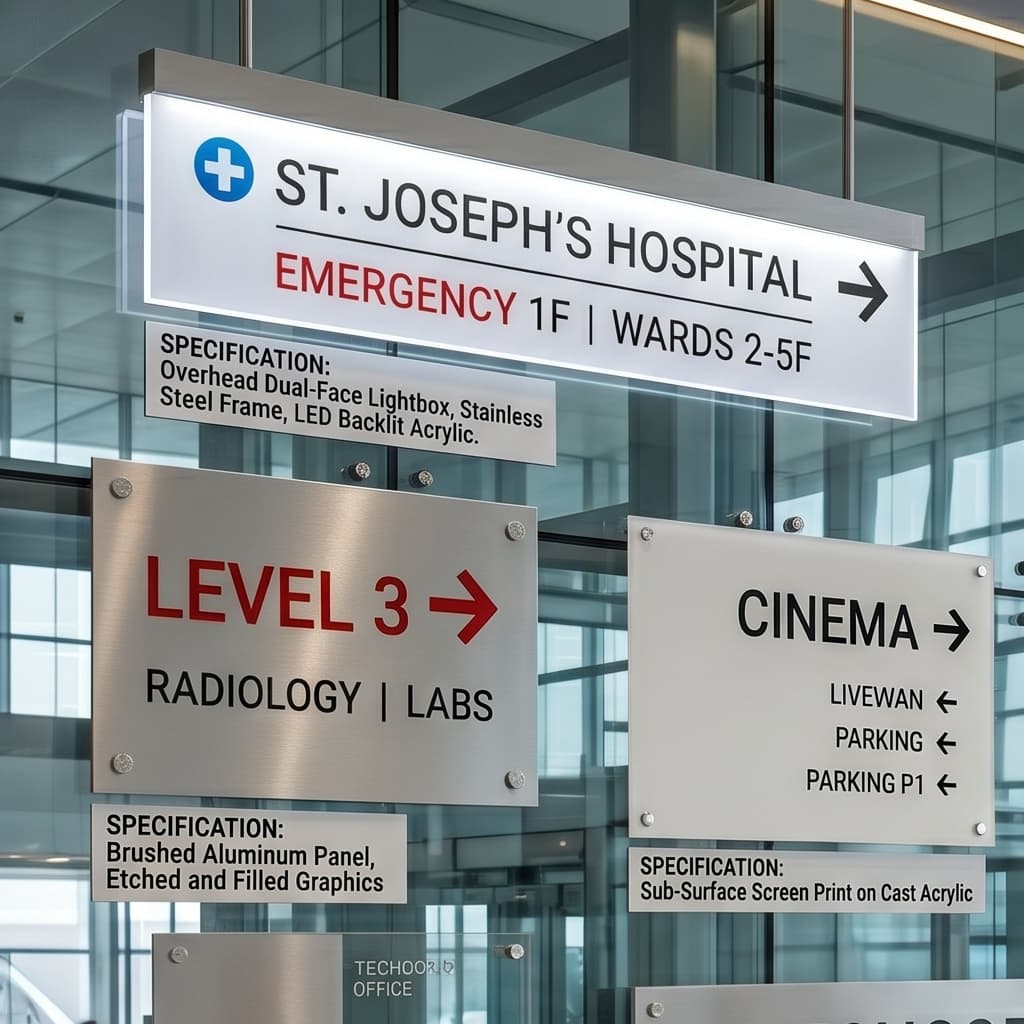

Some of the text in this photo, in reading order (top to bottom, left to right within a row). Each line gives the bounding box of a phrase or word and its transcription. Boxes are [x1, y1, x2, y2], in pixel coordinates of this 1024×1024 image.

[276, 159, 591, 259] ST. JOSEPH'S
[609, 223, 812, 301] HOSPITAL
[277, 253, 514, 322] EMERGENCY
[161, 333, 329, 375] SPECIFICATION:
[531, 297, 570, 332] 1F
[613, 309, 733, 360] WARDS
[745, 333, 811, 372] 2-5F
[161, 360, 542, 428] Overhead Dual-Face Lightbox, Stainless
[160, 386, 478, 445] Steel Frame, LED Backlit Acrylic.
[148, 556, 408, 636] LEVEL 3
[739, 590, 918, 650] CINEMA
[147, 669, 361, 713] RADIOLOGY
[408, 685, 492, 721] LABS
[831, 683, 922, 710] LIVEWAN
[837, 727, 922, 752] PARKING
[808, 769, 922, 794] PARKING P1
[107, 814, 283, 838] SPECIFICATION:
[108, 842, 374, 870] Brushed Aluminum Panel,
[641, 856, 783, 876] SPECIFICATION:
[107, 868, 383, 896] Etched and Filled Graphics
[641, 880, 972, 906] Sub-Surface Screen Print on Cast Acrylic
[354, 981, 412, 997] OFFICE
